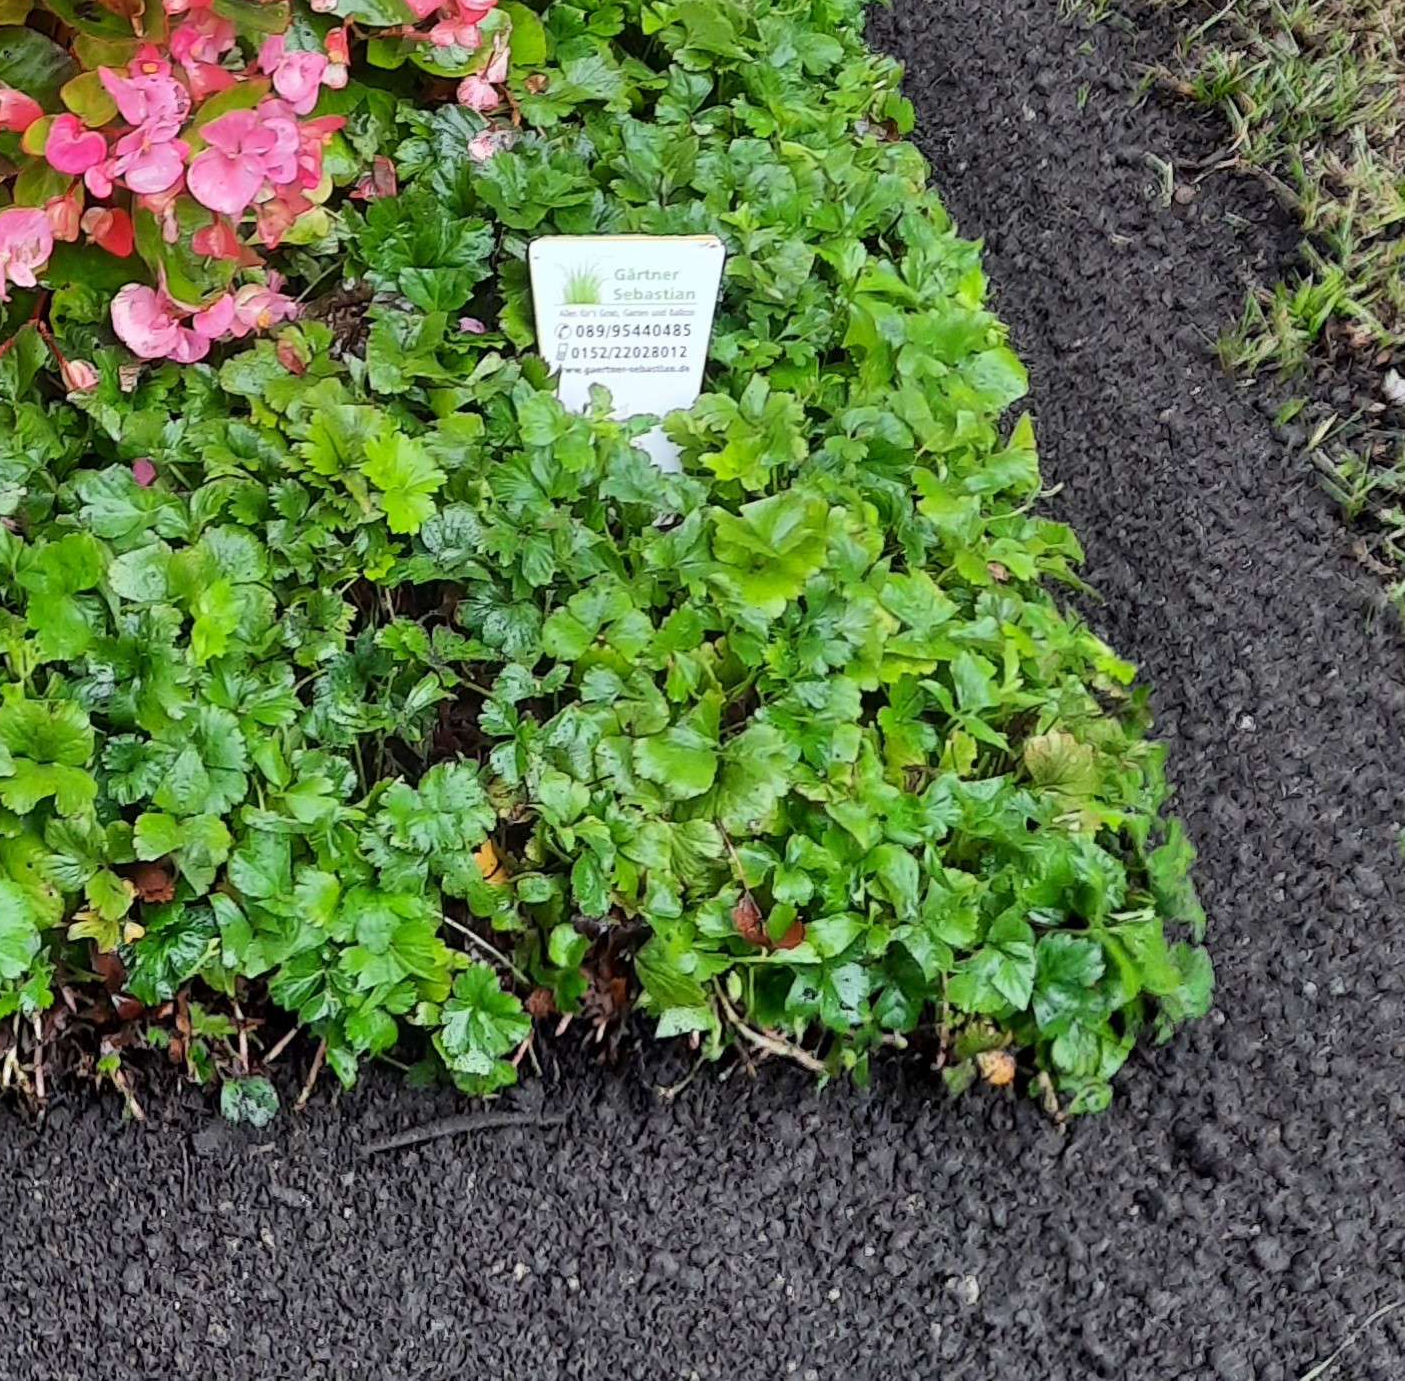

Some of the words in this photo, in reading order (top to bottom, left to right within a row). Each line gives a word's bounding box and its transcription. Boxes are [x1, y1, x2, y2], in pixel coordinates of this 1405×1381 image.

[614, 267, 680, 281] Gärtner
[613, 287, 695, 301] Sebastian
[575, 324, 692, 339] 089/95440485
[571, 345, 688, 360] 0152/22028012
[559, 364, 690, 375] ww.gaertner-sebastian.de
